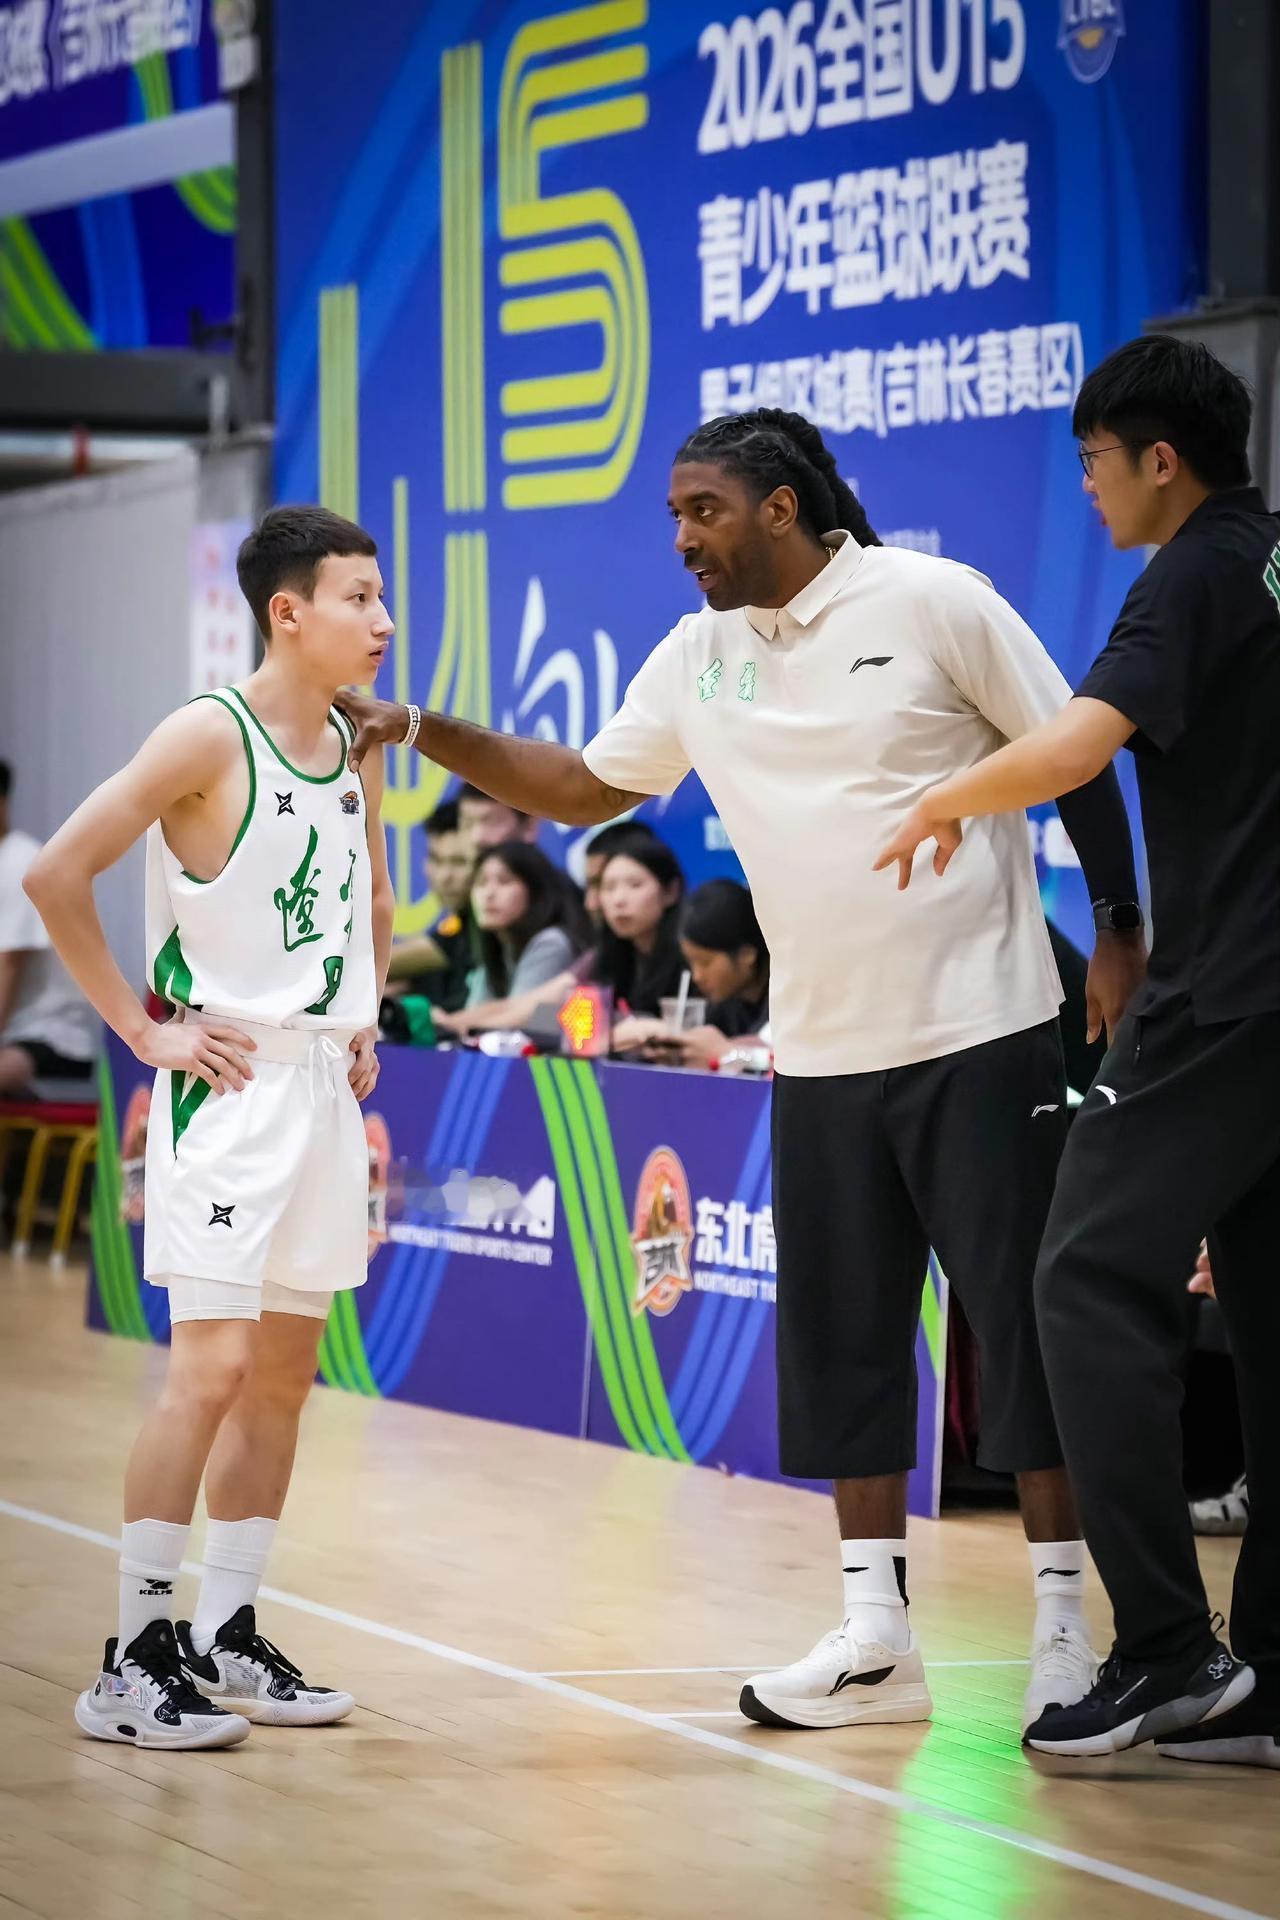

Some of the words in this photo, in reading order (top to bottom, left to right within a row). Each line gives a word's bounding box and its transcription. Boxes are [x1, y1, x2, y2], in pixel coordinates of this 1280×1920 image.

[697, 0, 1028, 156] 2026全国U15
[697, 139, 1032, 331] 青少年篮球联赛
